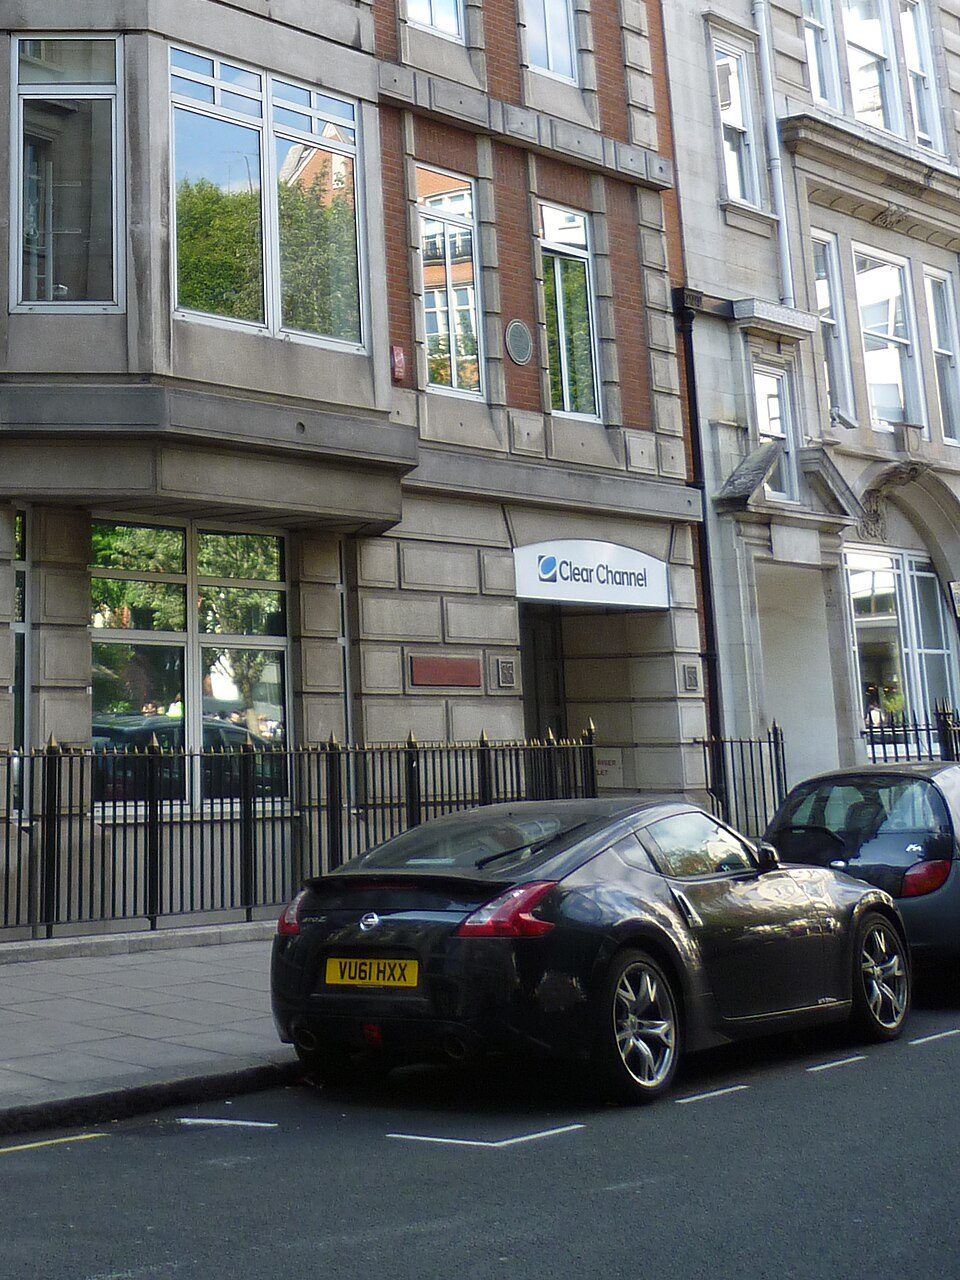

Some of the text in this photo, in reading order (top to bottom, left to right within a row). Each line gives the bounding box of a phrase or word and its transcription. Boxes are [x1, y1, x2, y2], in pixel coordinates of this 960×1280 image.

[559, 560, 647, 587] Clear Channel
[339, 961, 407, 981] VU61 HXX
